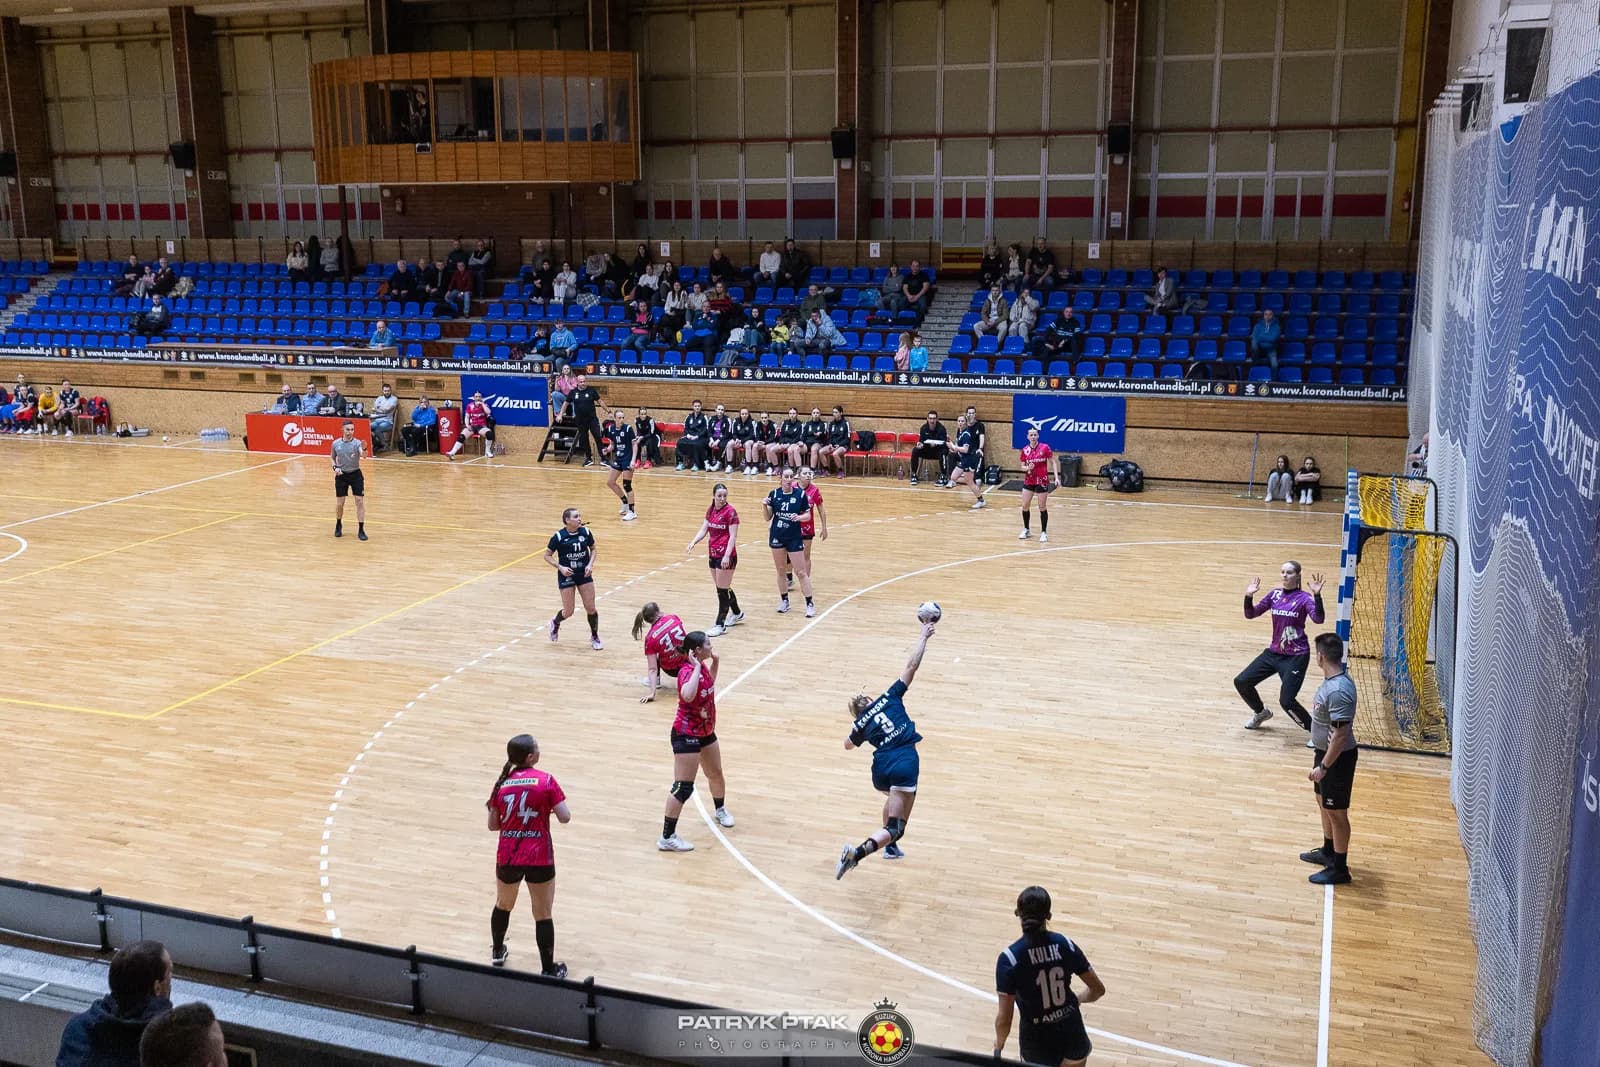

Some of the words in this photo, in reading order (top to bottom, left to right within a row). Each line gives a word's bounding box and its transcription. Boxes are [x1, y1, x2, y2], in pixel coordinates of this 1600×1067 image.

[86, 349, 161, 360] www.koronahandball.pl
[197, 352, 277, 364] www.koronahandball.pl
[315, 355, 400, 368] www.koronahandball.pl
[766, 370, 870, 383] www.koronahandball.pl
[922, 375, 1034, 388] www.koronahandball.pl
[1091, 379, 1211, 394] www.koronahandball.pl
[1272, 386, 1405, 401] www.koronahandball.pl
[781, 502, 789, 511] 21
[874, 712, 895, 734] 3
[1027, 944, 1063, 965] KULIK
[1036, 966, 1067, 1009] 16
